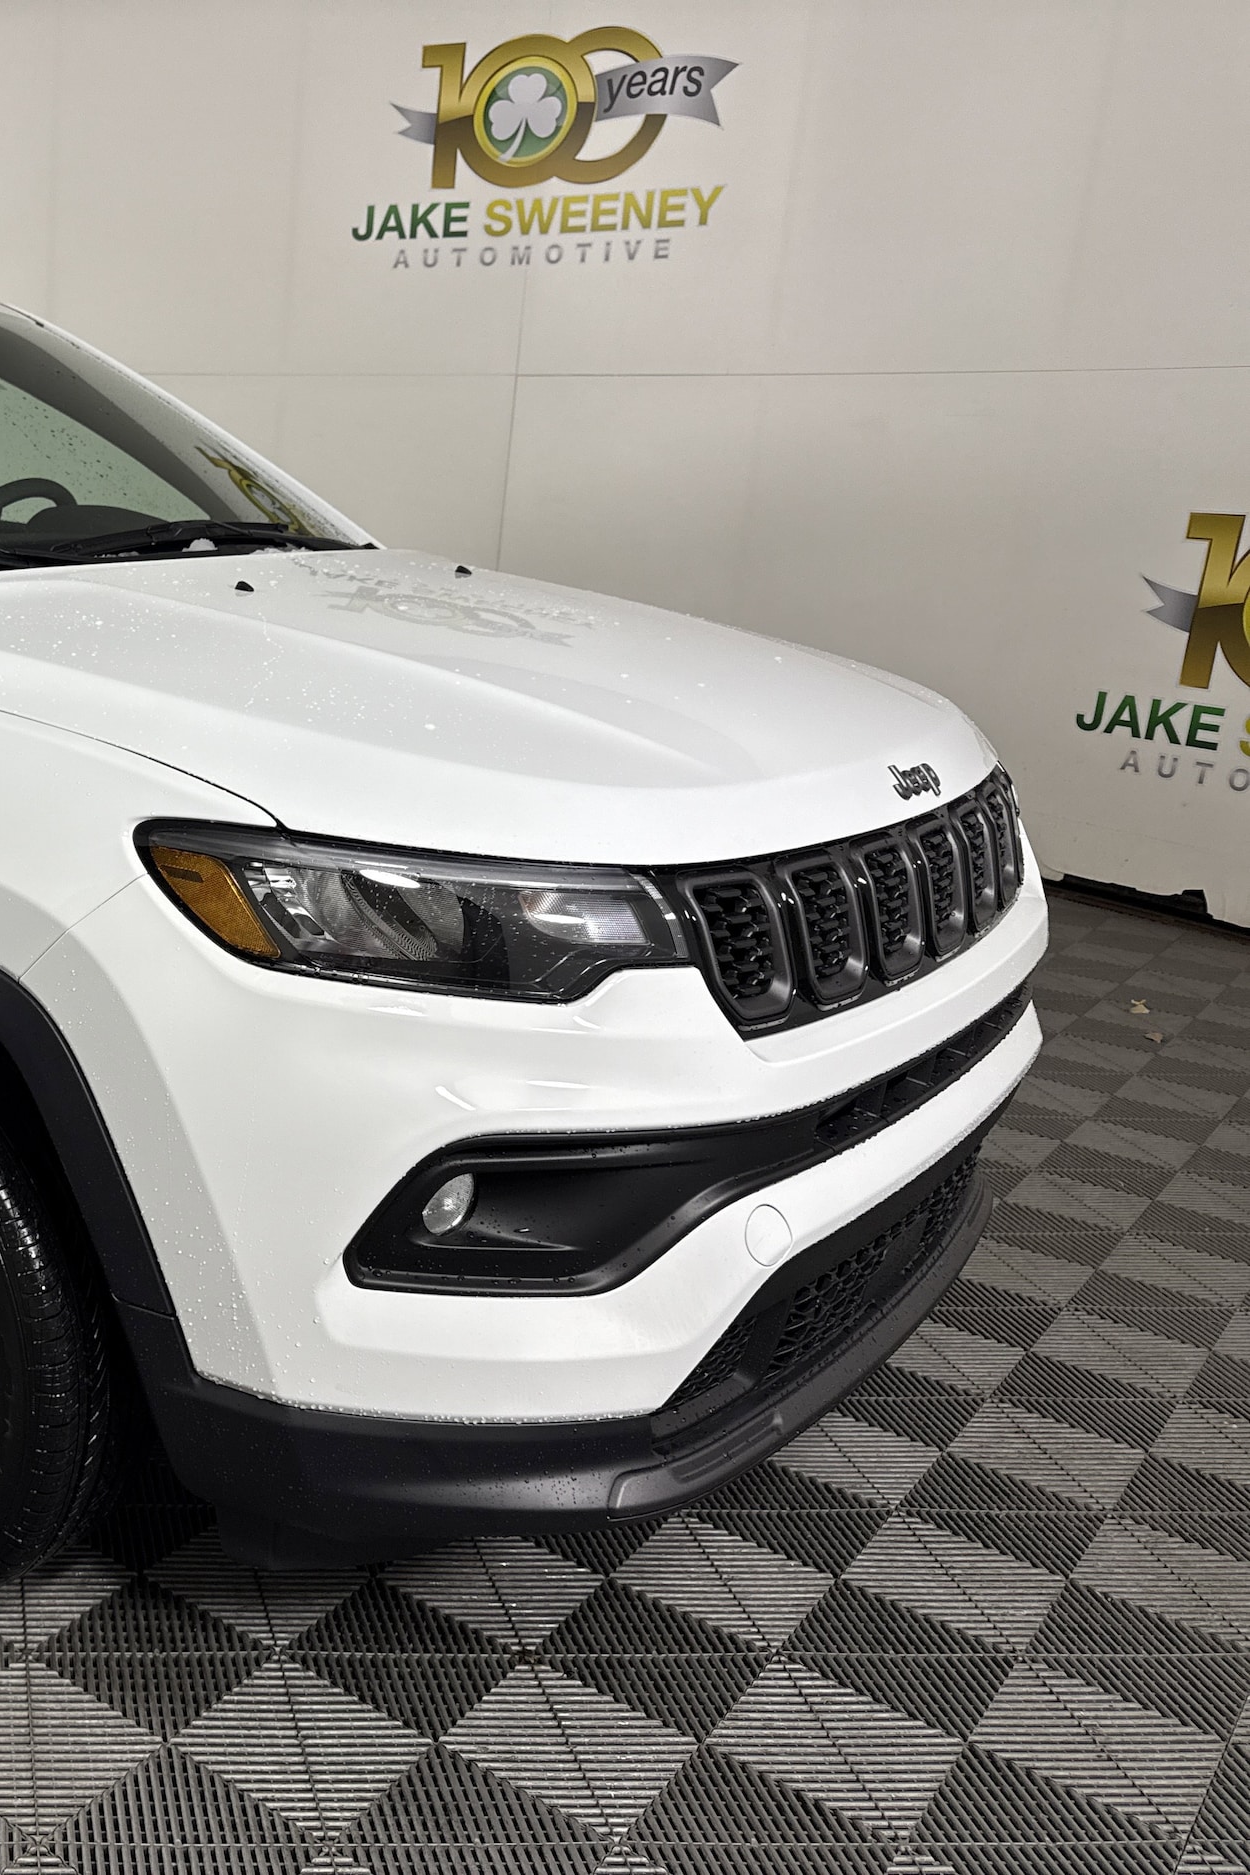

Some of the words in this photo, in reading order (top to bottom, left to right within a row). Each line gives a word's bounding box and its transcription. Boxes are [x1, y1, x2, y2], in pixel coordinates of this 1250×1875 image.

[422, 26, 667, 188] 100
[603, 65, 705, 113] years
[351, 202, 470, 241] JAKE
[484, 185, 726, 238] SWEENEY
[393, 239, 672, 269] AUTOMOTIVE
[1076, 691, 1226, 751] JAKE
[887, 763, 941, 801] Jeep
